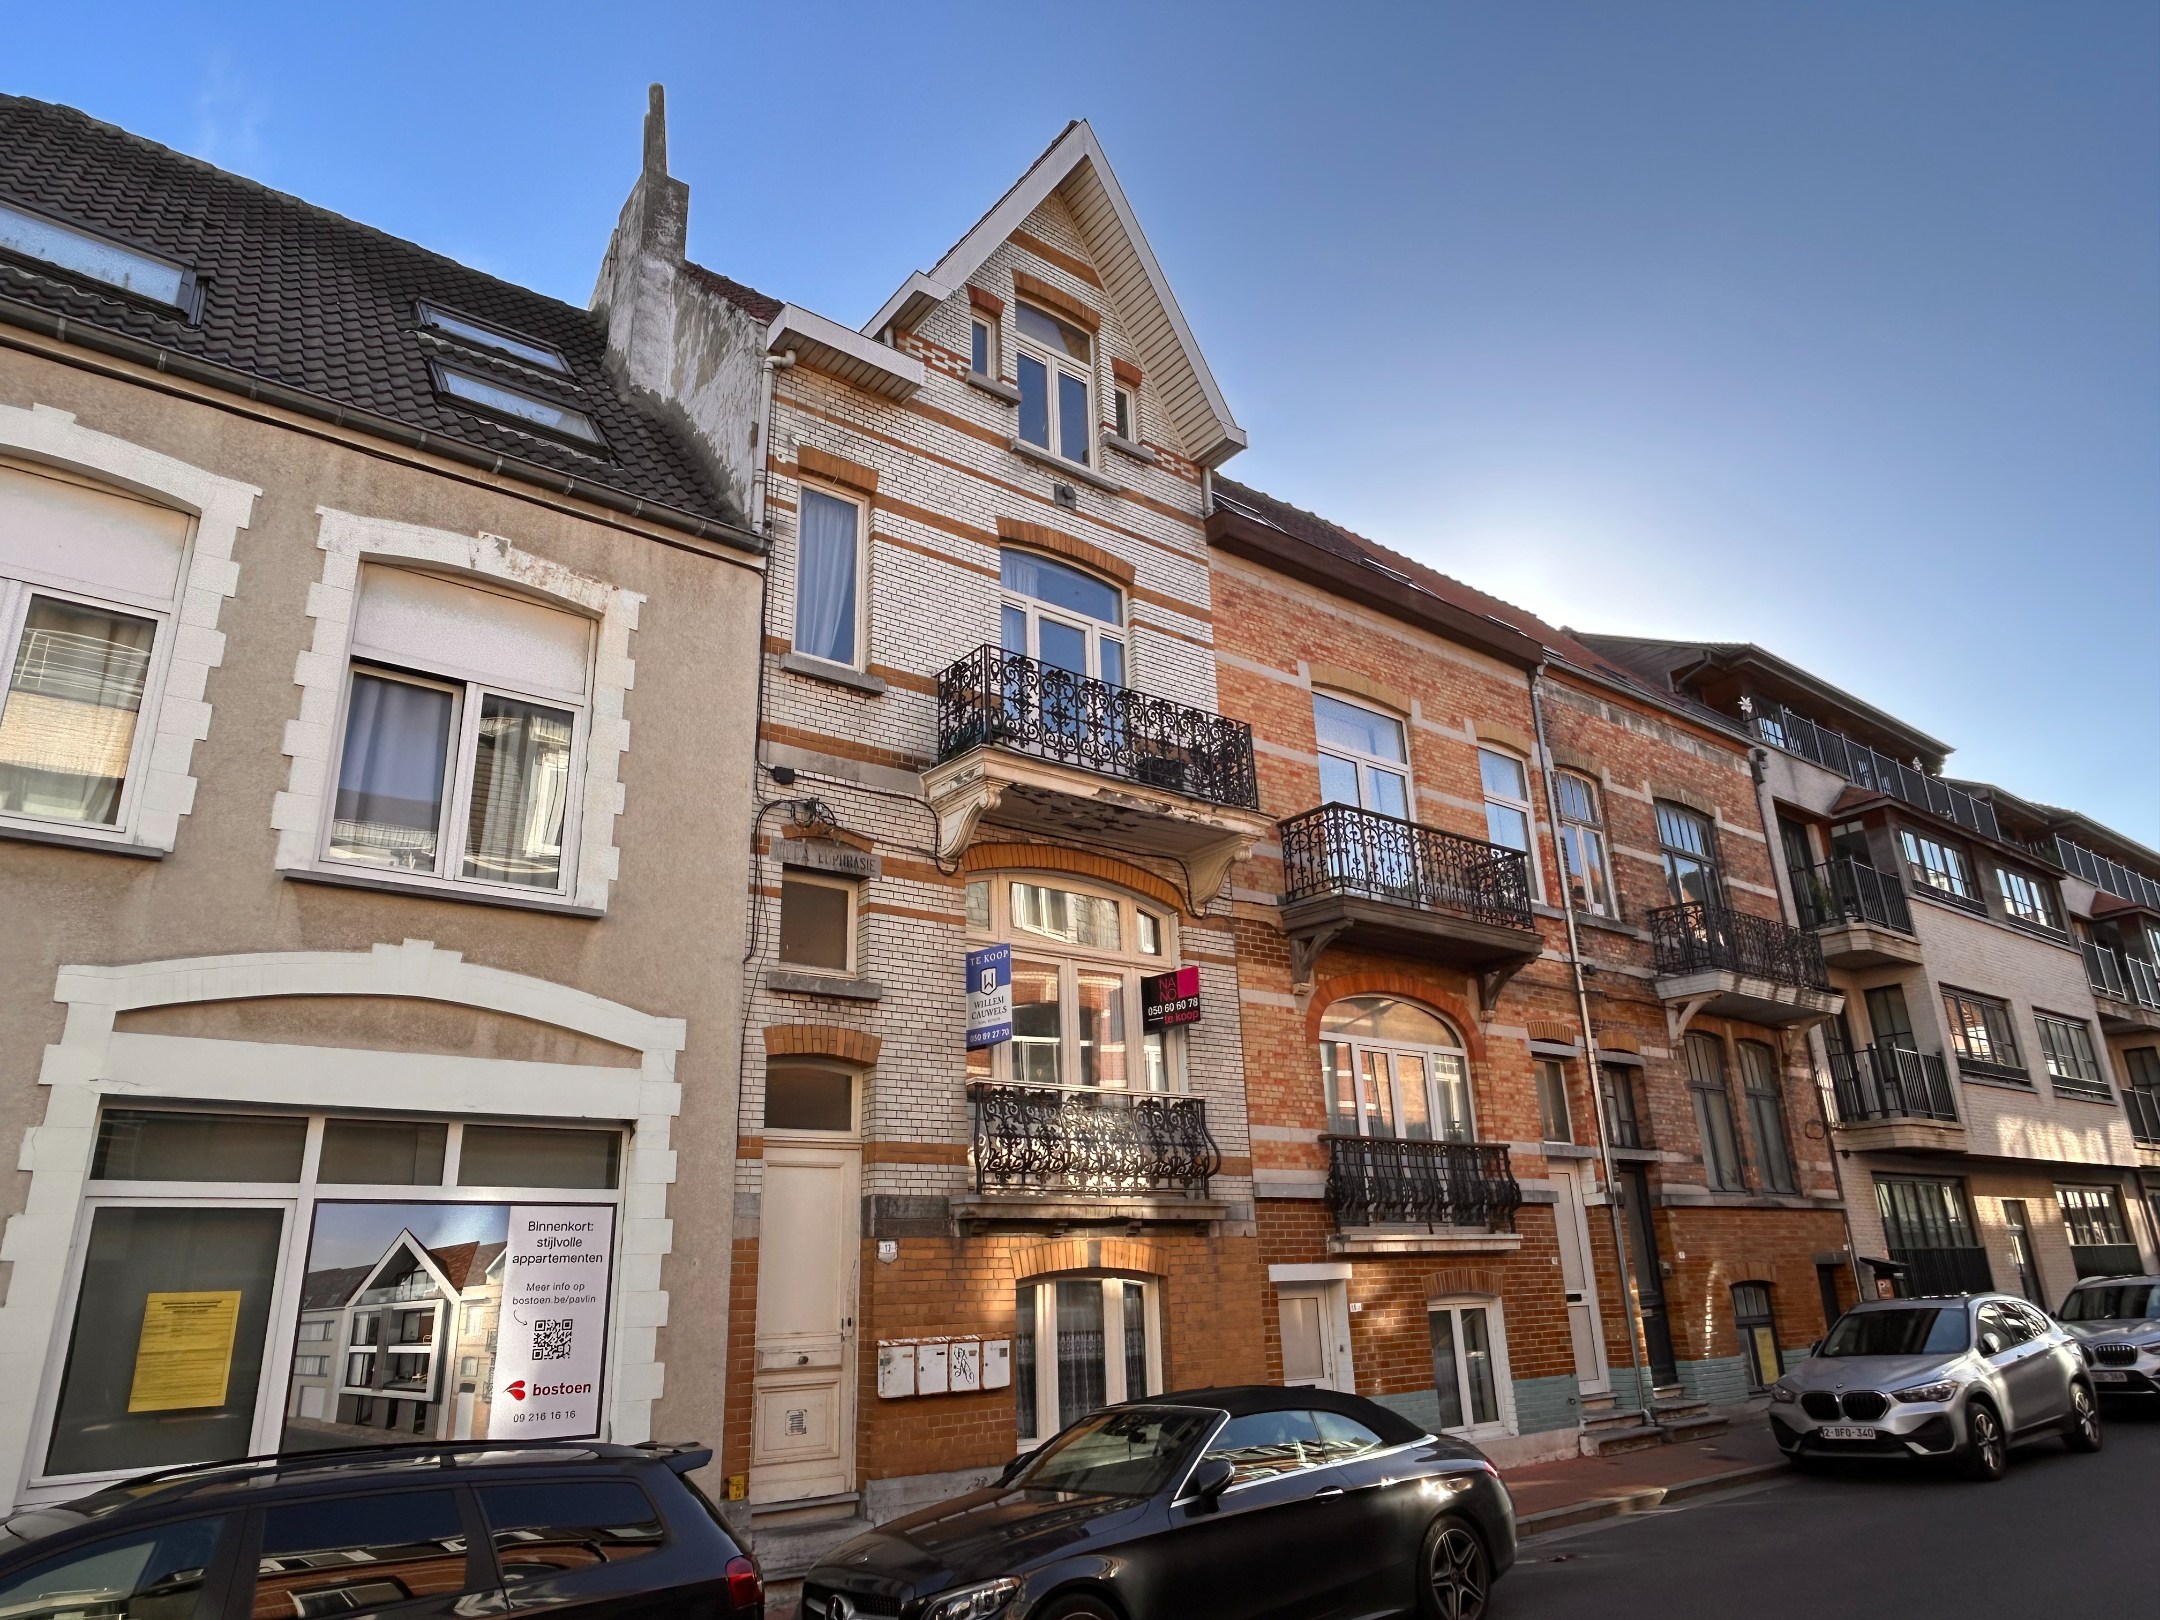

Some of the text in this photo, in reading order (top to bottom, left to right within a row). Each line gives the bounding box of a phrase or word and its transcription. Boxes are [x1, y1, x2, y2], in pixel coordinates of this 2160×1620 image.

[970, 949, 1009, 966] TE KOOP
[974, 996, 1004, 1009] WILLEM
[1148, 1005, 1163, 1016] 050
[1164, 1002, 1175, 1013] 60
[1176, 999, 1187, 1011] 60
[971, 1005, 1007, 1020] CAUWELS
[1175, 1010, 1198, 1021] koop
[992, 1029, 1000, 1039] 27
[1001, 1027, 1010, 1037] 70
[528, 1220, 594, 1232] Binnenkort:
[536, 1237, 583, 1250] stijlvolle
[512, 1253, 603, 1267] appartementen
[526, 1282, 585, 1293] Meer info op
[532, 1382, 592, 1397] bostoen
[513, 1410, 576, 1423] 09 216 16 16
